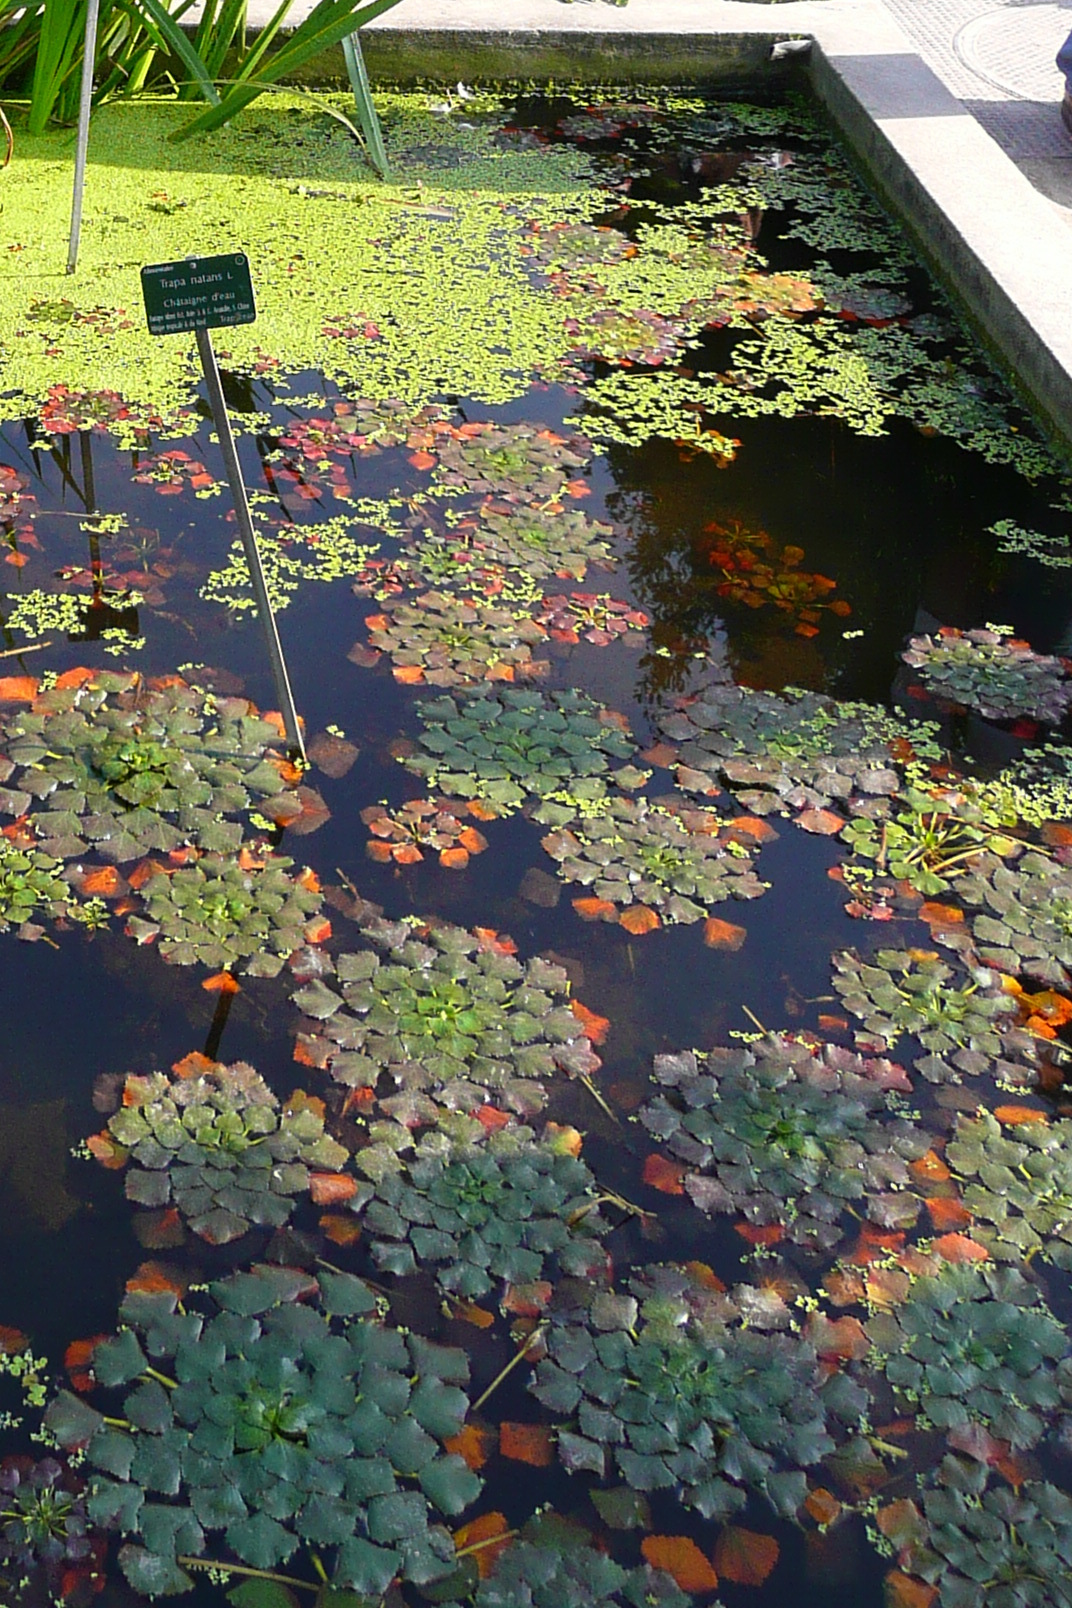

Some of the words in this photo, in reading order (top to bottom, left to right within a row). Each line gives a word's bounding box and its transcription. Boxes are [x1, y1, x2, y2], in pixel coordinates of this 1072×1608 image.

[159, 278, 186, 290] Trapa
[190, 272, 223, 285] natans
[212, 291, 236, 302] d'eau
